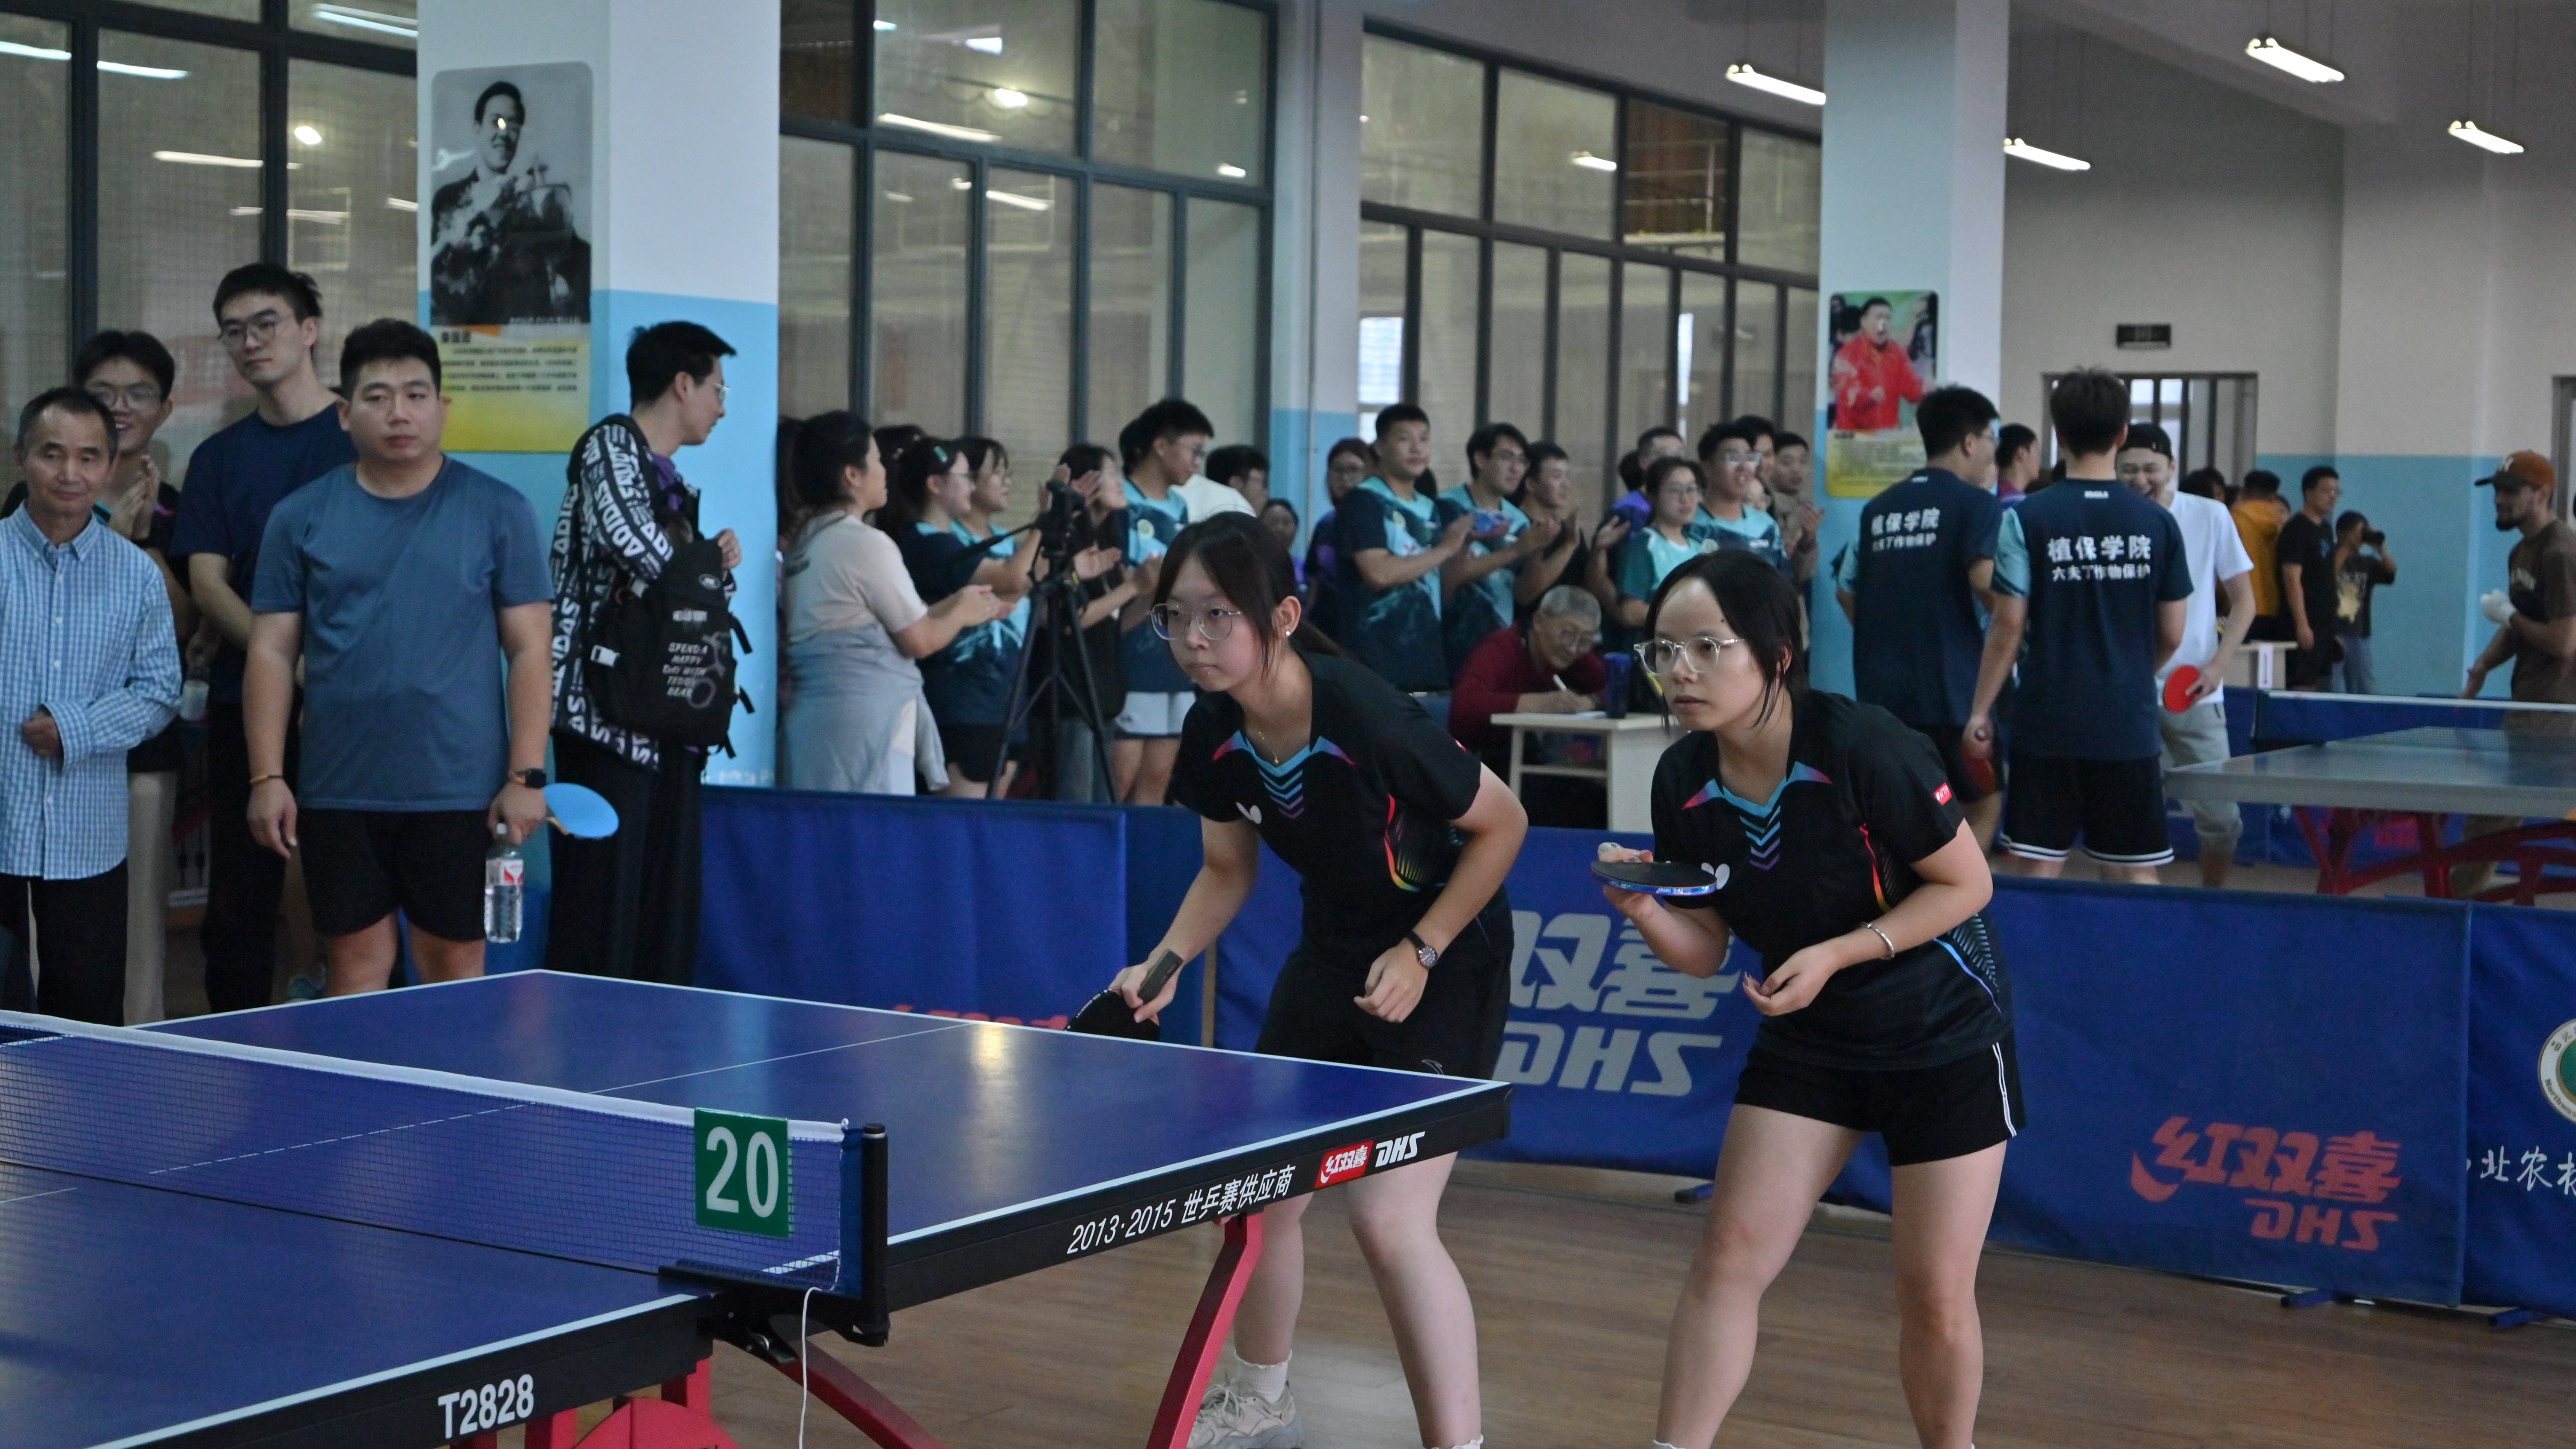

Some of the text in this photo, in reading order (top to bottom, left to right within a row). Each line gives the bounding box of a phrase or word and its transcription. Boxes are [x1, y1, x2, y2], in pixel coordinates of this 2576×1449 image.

[2048, 534, 2151, 563] 植保学院
[1492, 1021, 1723, 1097] DHS
[706, 1126, 779, 1218] 20
[1320, 1131, 1425, 1184] 红双喜 DHS
[2130, 1115, 2402, 1202] 红双喜
[2466, 1145, 2576, 1196] 北农
[1181, 1164, 1296, 1224] 世乒赛供应商
[2244, 1199, 2398, 1251] DHS
[438, 1373, 534, 1439] T2828
